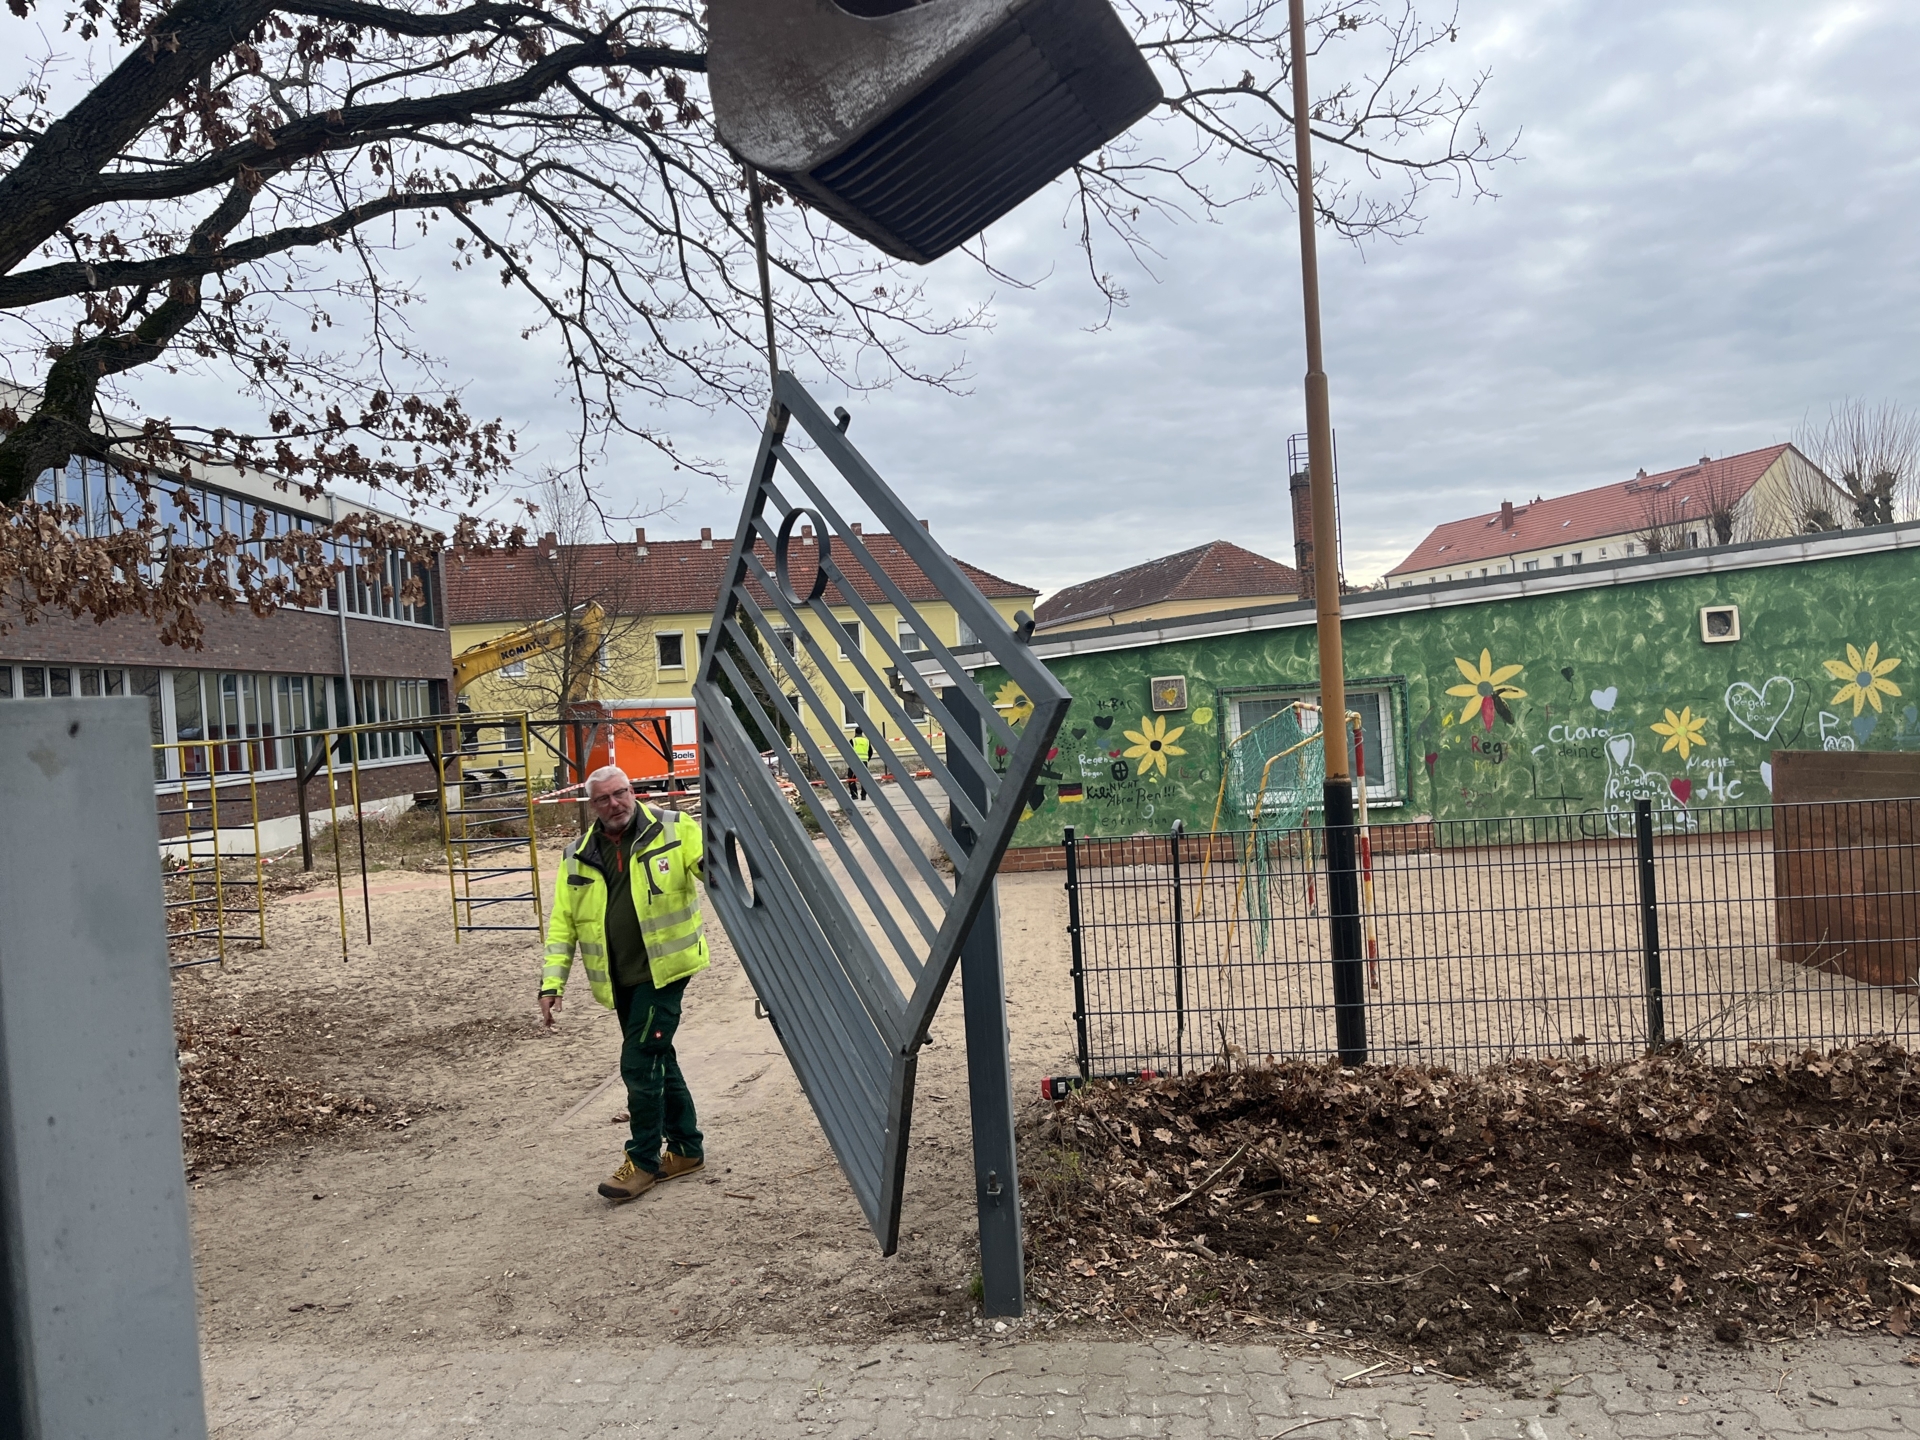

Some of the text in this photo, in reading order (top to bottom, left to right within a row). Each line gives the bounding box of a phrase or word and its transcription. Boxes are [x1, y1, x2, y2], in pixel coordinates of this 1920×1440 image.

[501, 637, 550, 660] KOMATSU
[1548, 725, 1611, 743] Clara
[672, 751, 695, 759] Boels
[1109, 779, 1139, 793] NICHT
